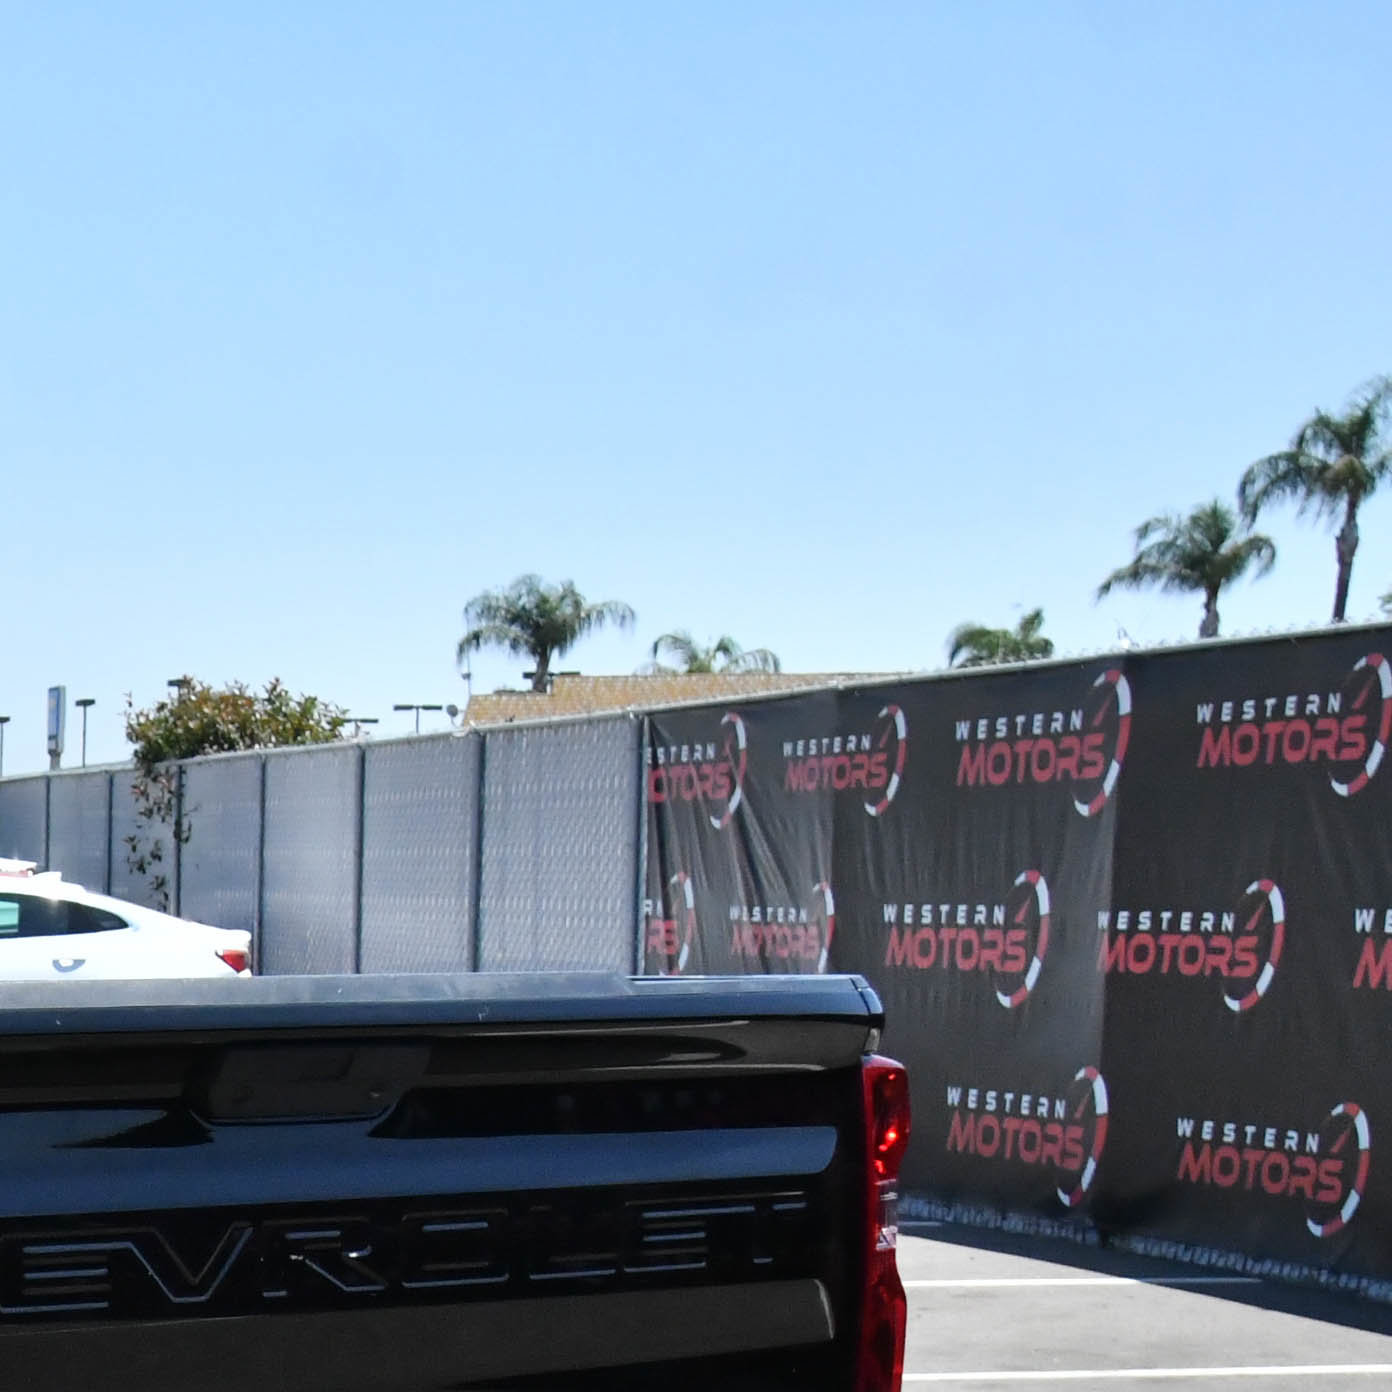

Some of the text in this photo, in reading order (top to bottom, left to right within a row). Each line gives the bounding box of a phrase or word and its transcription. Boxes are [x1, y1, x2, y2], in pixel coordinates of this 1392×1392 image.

[955, 709, 1083, 741] WESTERN
[1195, 692, 1341, 723] WESTERN
[783, 734, 871, 757] WESTERN
[956, 733, 1105, 787] MOTORS
[1195, 714, 1367, 769] MOTORS
[784, 753, 888, 792] MOTORS
[883, 903, 1006, 926] WESTERN
[1097, 908, 1235, 932] WESTERN
[885, 928, 1027, 973] MOTORS
[1096, 932, 1259, 978] MOTORS
[947, 1085, 1066, 1119] WESTERN
[946, 1110, 1085, 1171] MOTORS
[1177, 1117, 1319, 1153] WESTERN
[1177, 1141, 1344, 1203] MOTORS
